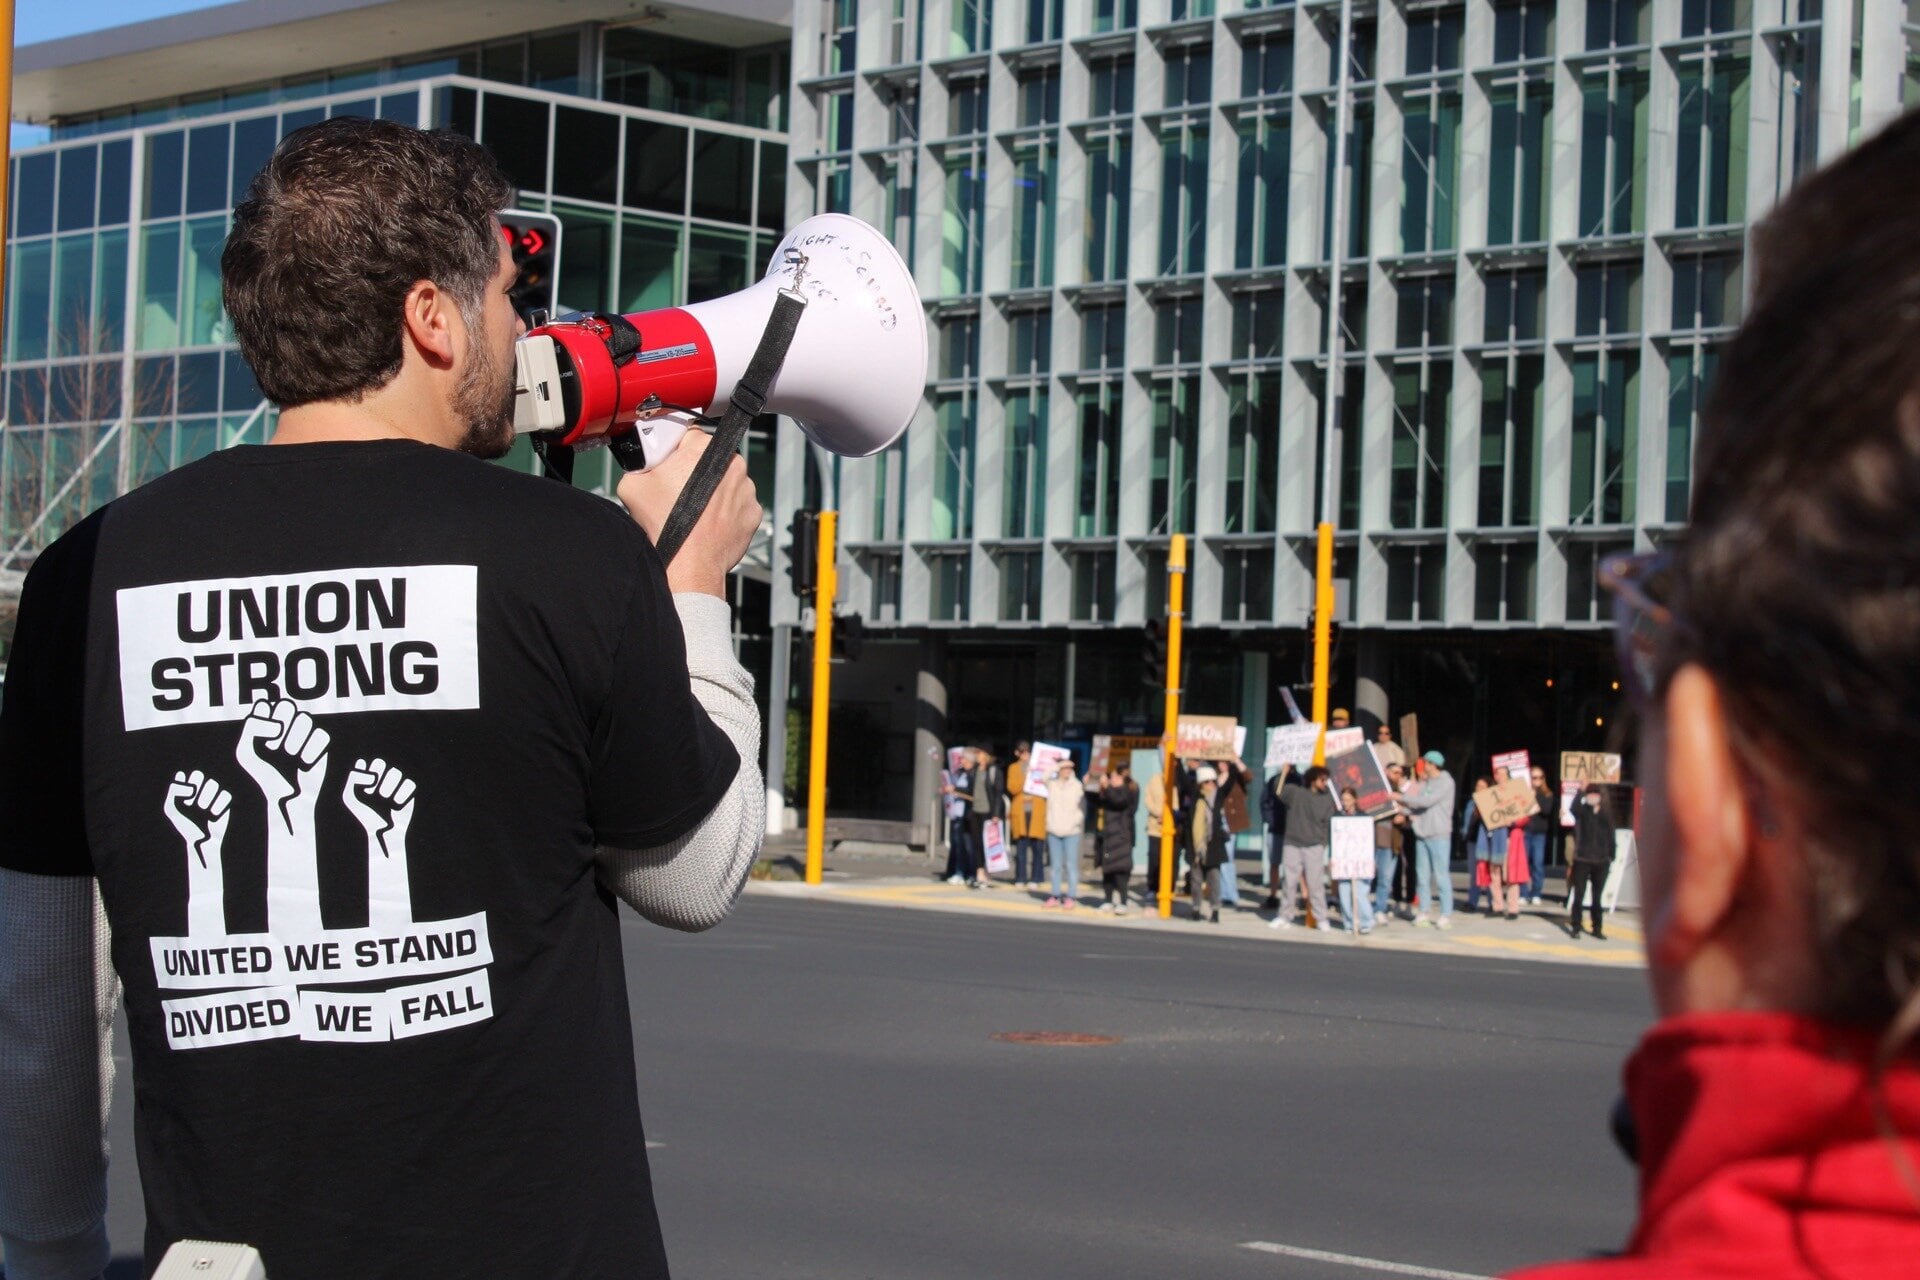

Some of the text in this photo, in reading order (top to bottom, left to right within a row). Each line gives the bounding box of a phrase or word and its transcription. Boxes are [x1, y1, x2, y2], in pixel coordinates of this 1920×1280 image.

[177, 578, 407, 643] UNION
[150, 641, 440, 711] STRONG
[163, 928, 478, 976] UNITED WE STAND
[171, 986, 485, 1039] DIVIDED WE FALL
